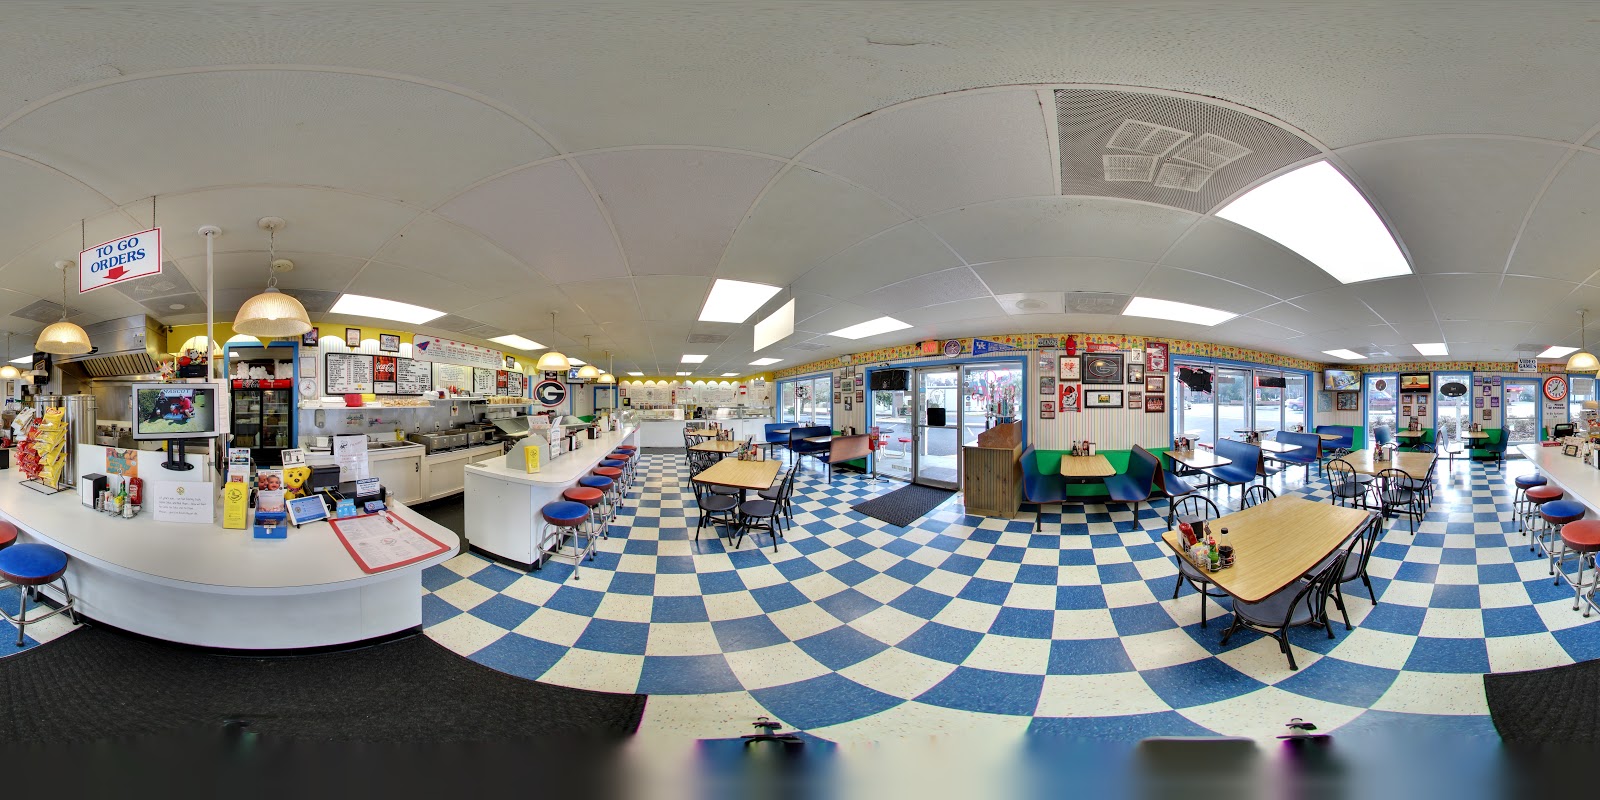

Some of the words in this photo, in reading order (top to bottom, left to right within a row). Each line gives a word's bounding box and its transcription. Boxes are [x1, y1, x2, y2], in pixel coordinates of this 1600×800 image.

[96, 244, 113, 258] TO
[117, 237, 139, 251] GO
[91, 248, 146, 273] ORDERS
